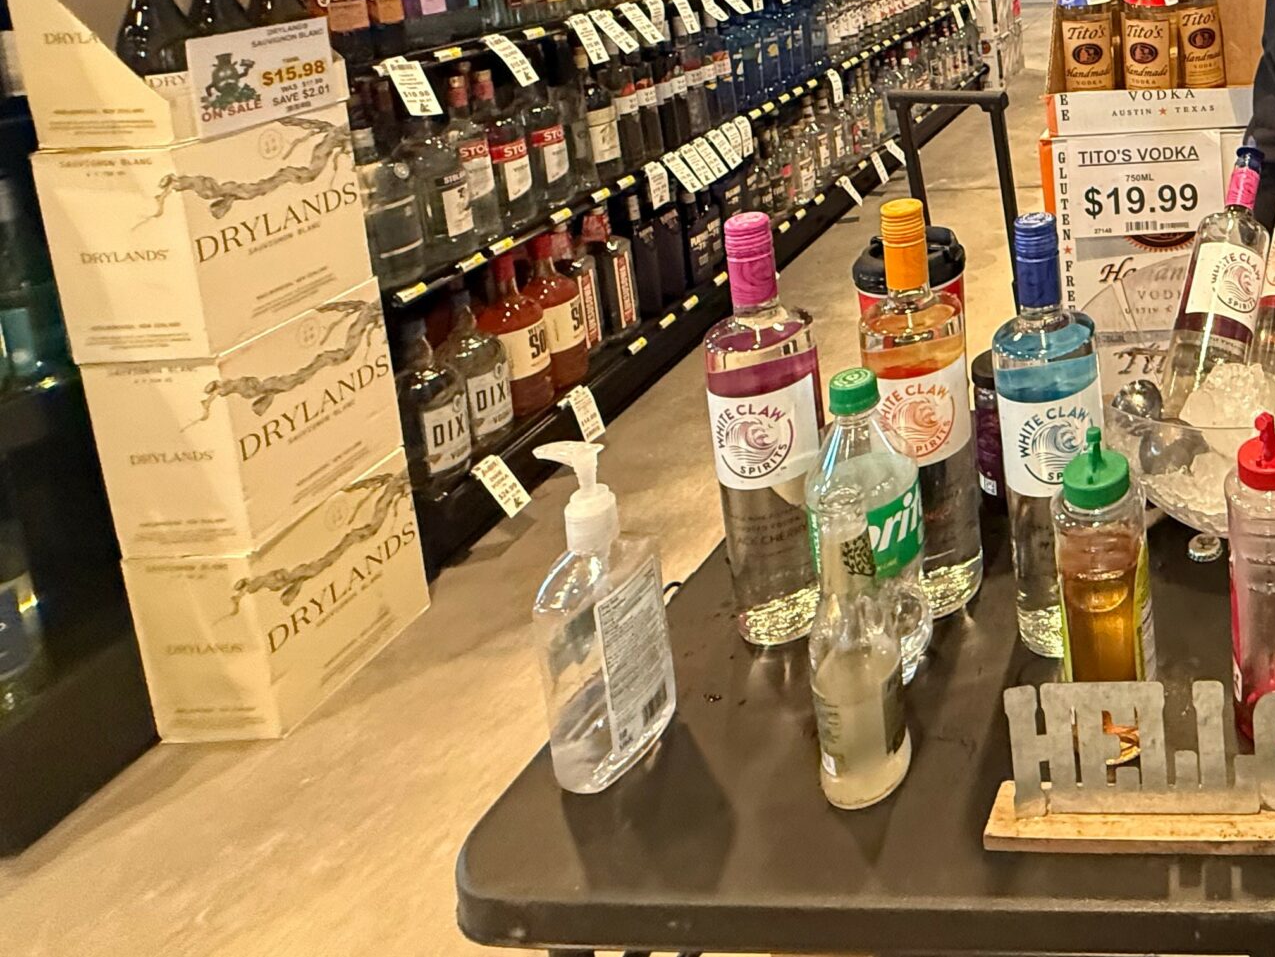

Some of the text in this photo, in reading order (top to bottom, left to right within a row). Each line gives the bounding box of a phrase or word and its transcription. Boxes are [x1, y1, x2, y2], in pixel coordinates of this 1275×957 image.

[1126, 23, 1164, 39] Tito's
[1181, 8, 1216, 28] Tito's
[1067, 23, 1106, 41] Tito's
[262, 59, 326, 87] $15.98
[272, 84, 330, 106] SAVE $2.01
[1128, 89, 1196, 102] VODKA
[201, 97, 263, 122] ON SALE
[1111, 105, 1216, 117] AUSTIN TEXAS
[1078, 145, 1200, 164] TITO'S VODKA
[1125, 173, 1155, 182] 750ML
[1058, 151, 1071, 241] GLUTEN
[1084, 183, 1199, 220] $19.99
[195, 182, 358, 263] DRYLANDS
[80, 249, 169, 265] DRYLANDS
[1239, 252, 1261, 281] CLAW
[905, 384, 949, 400] CLAW
[239, 354, 390, 462] DRYLANDS
[432, 412, 466, 448] DIX
[717, 403, 786, 450] WHITE CLAW
[1018, 405, 1090, 459] WHITE CLAW
[739, 442, 788, 476] SPIRITS
[267, 521, 416, 654] DRYLANDS
